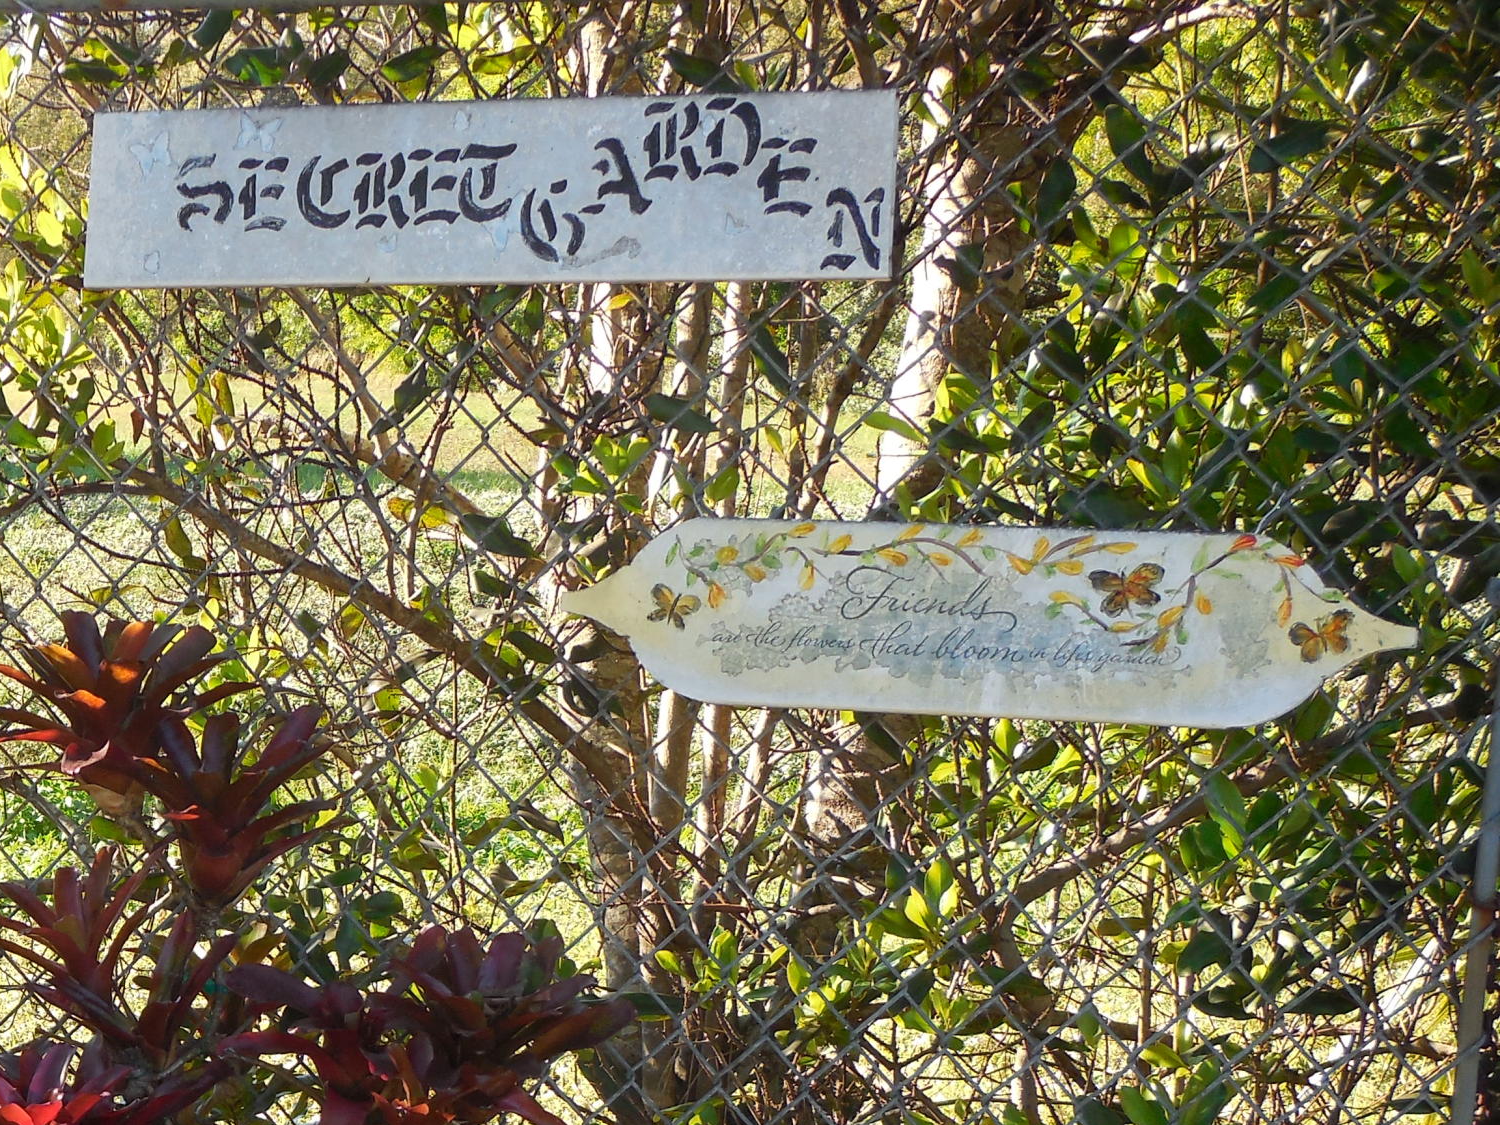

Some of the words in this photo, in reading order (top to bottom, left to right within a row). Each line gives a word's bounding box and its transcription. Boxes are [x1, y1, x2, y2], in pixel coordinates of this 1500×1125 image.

[176, 142, 518, 232] SECRET
[520, 97, 886, 271] GARDEN
[841, 565, 1018, 633] Friends
[711, 630, 743, 643] are
[746, 620, 786, 649] the
[781, 624, 855, 654] flowers
[859, 620, 930, 659] that
[932, 626, 1025, 663] bloom
[1028, 647, 1048, 659] in
[1091, 646, 1182, 673] garden
